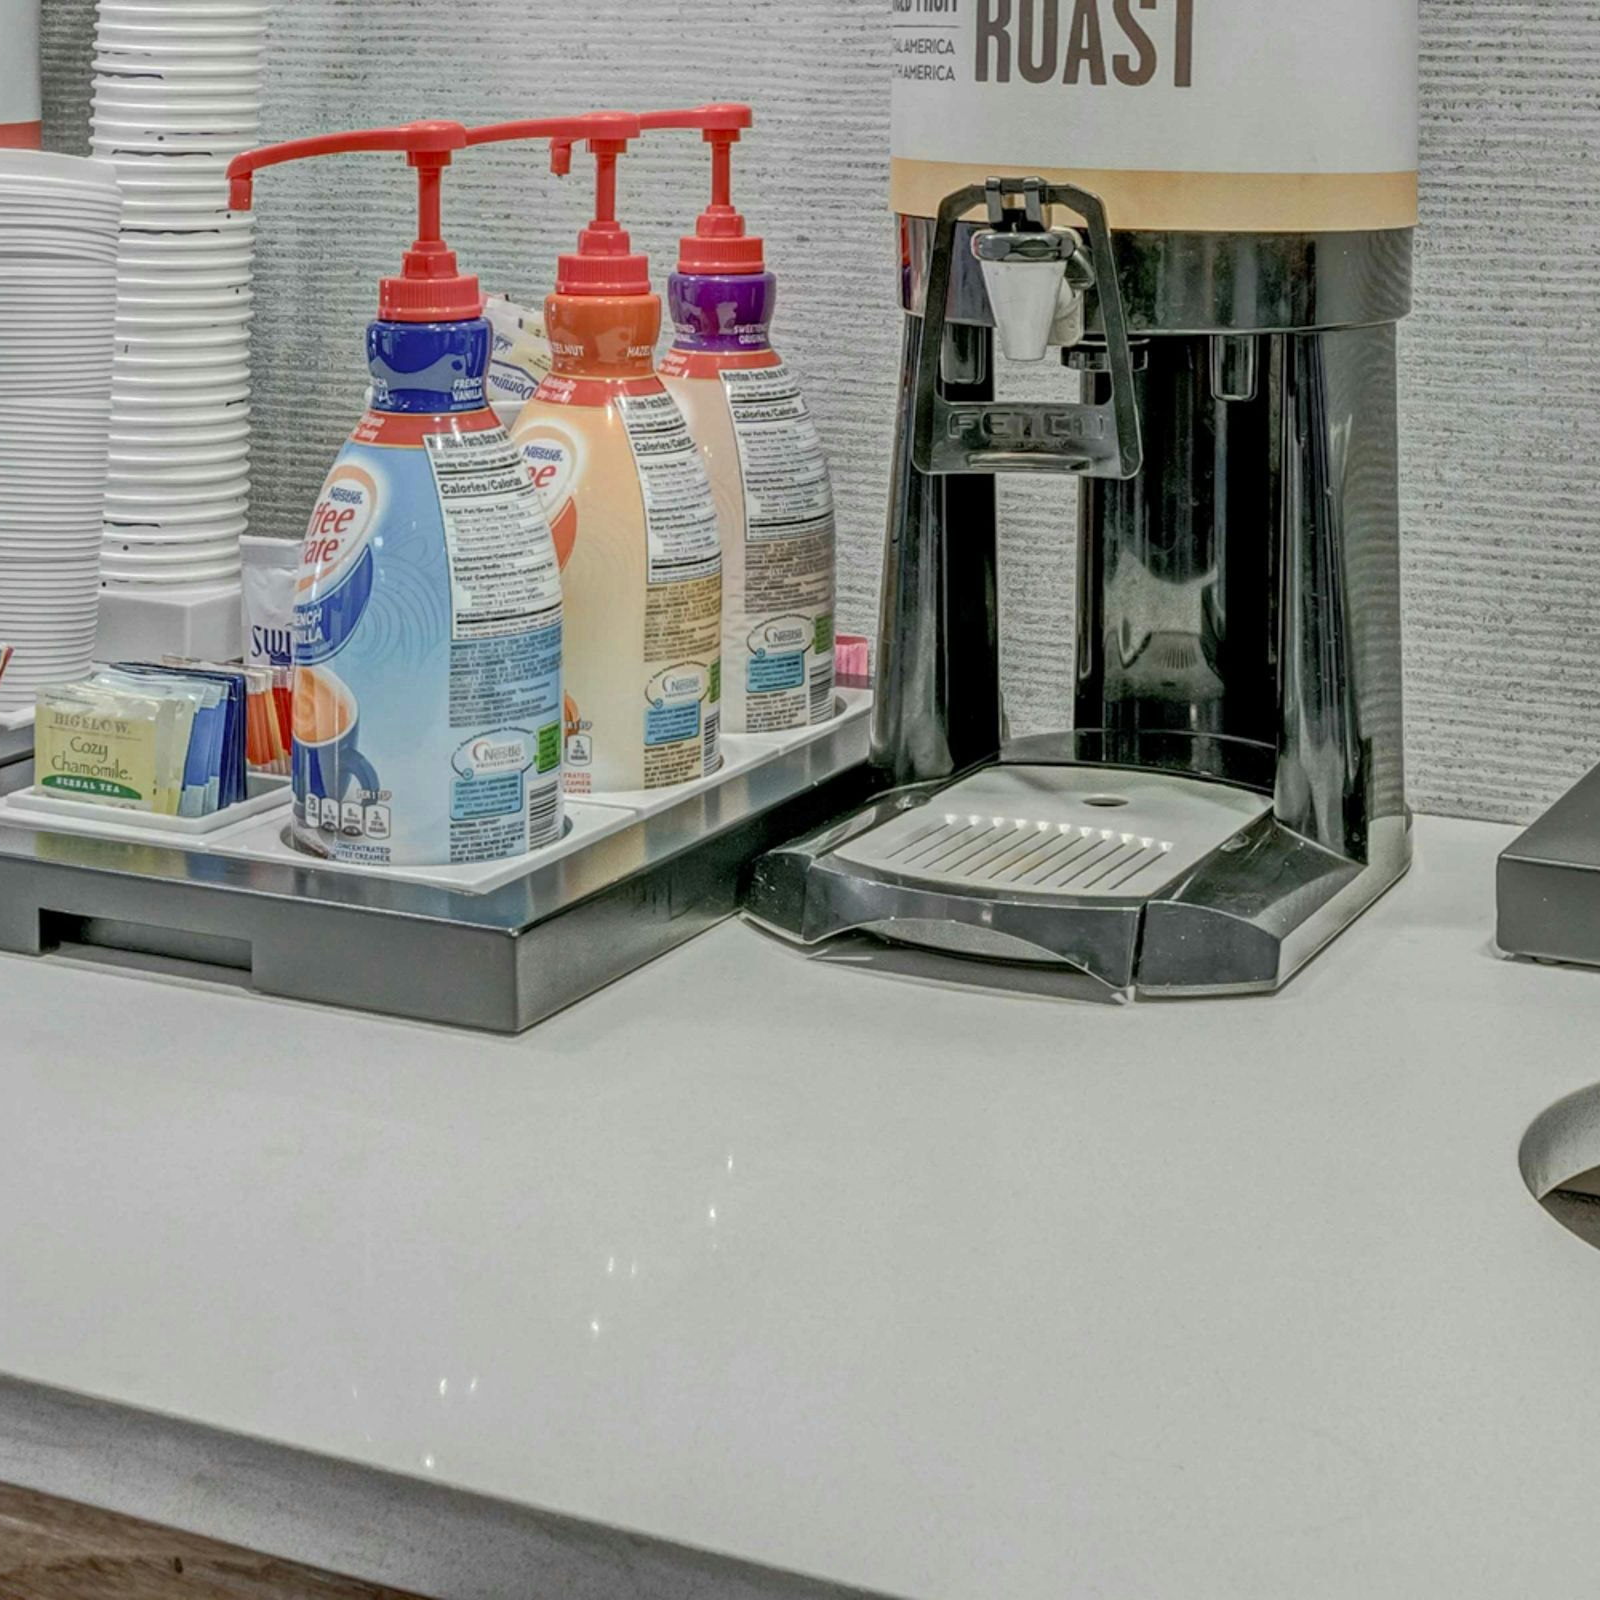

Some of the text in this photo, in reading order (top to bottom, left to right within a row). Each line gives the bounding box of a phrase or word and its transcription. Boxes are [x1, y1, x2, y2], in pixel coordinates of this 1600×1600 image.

[903, 37, 956, 55] AMERICA
[903, 64, 957, 81] AMERICA
[70, 736, 109, 764] Cozy
[56, 776, 121, 793] HERBAL TEA
